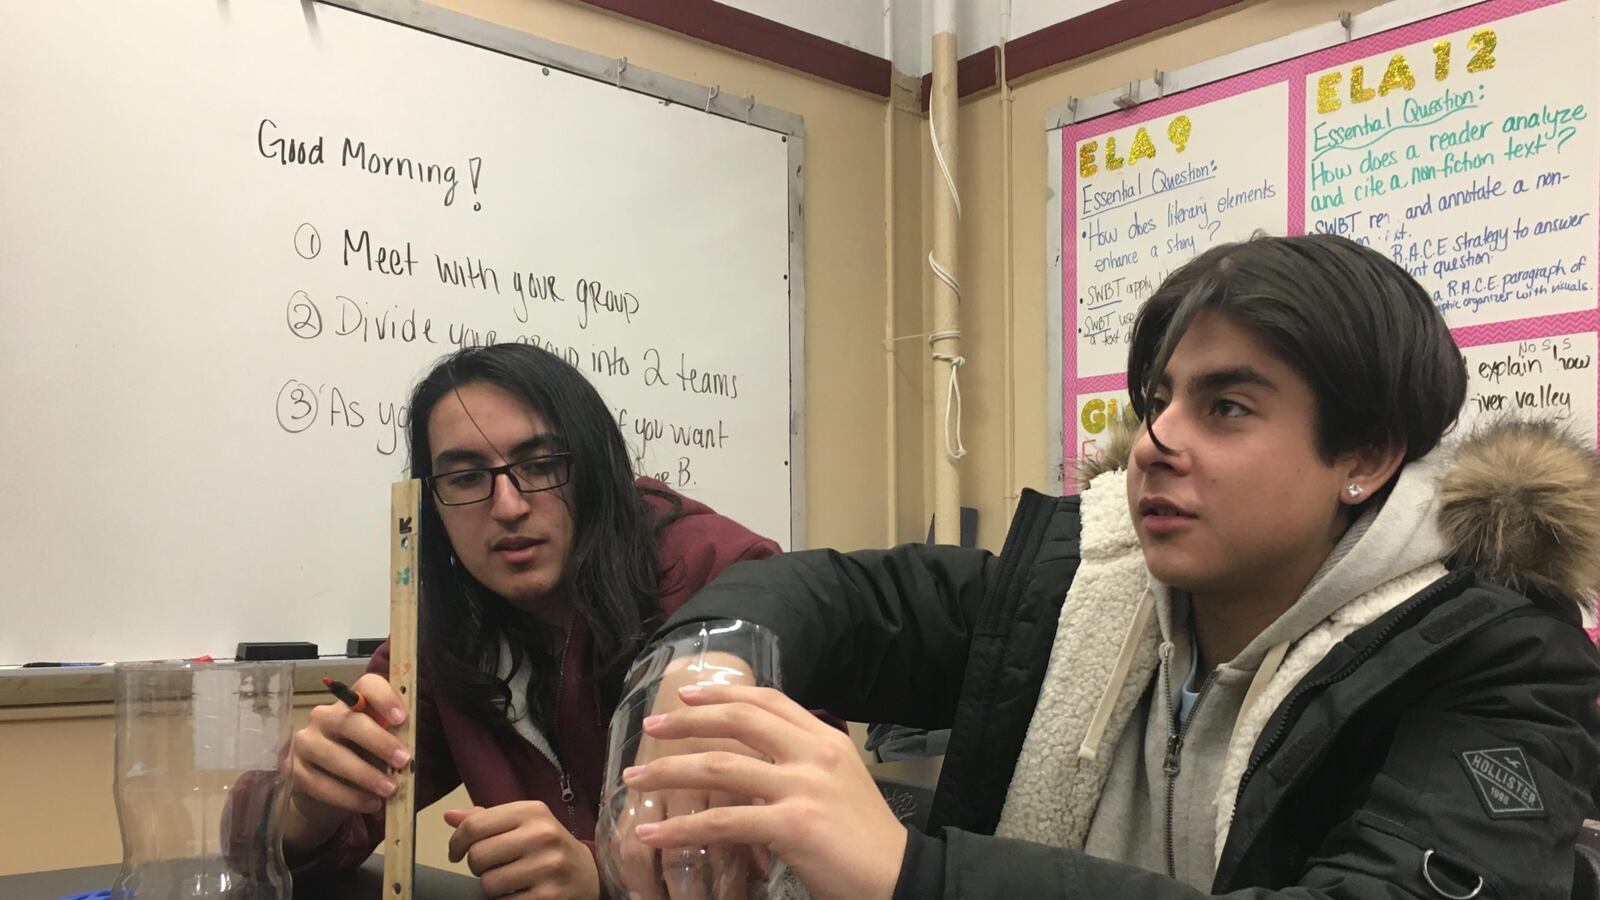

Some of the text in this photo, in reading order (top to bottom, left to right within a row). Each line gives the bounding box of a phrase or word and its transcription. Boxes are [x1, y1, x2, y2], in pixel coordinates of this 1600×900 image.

[1317, 53, 1416, 114] ELA
[257, 118, 324, 165] Good
[1079, 127, 1157, 178] ELA
[1311, 103, 1587, 191] How does a reader analyze
[1314, 106, 1391, 152] Essential
[1081, 159, 1218, 215] Essential Question:
[1311, 191, 1343, 211] and
[1354, 174, 1387, 202] cite
[1411, 150, 1495, 185] non-fiction
[1315, 211, 1362, 234] SWBT
[1405, 194, 1433, 221] and
[1438, 179, 1506, 212] annotate
[1513, 180, 1528, 193] a
[1536, 170, 1571, 189] non-
[1089, 179, 1277, 252] How does literary elements
[1513, 218, 1529, 238] to
[1535, 212, 1591, 234] answer
[343, 228, 419, 276] Meet
[1094, 249, 1139, 273] enhance
[1150, 246, 1159, 257] a
[1087, 276, 1126, 306] SWBT
[1127, 274, 1154, 299] apply
[1433, 290, 1443, 302] a
[1503, 259, 1566, 291] paragraph
[1570, 255, 1587, 273] of
[1463, 291, 1513, 313] organizer
[1516, 284, 1548, 300] with
[1084, 311, 1116, 335] SWBT
[1103, 329, 1120, 347] text
[335, 295, 437, 345] Divide
[592, 343, 630, 376] into
[643, 348, 669, 387] 2
[676, 352, 738, 399] teams
[1478, 354, 1542, 384] explain
[331, 387, 365, 429] As
[1515, 383, 1571, 419] valley
[634, 417, 663, 459] you
[669, 419, 729, 449] want
[1472, 754, 1536, 806] HOLLISTER
